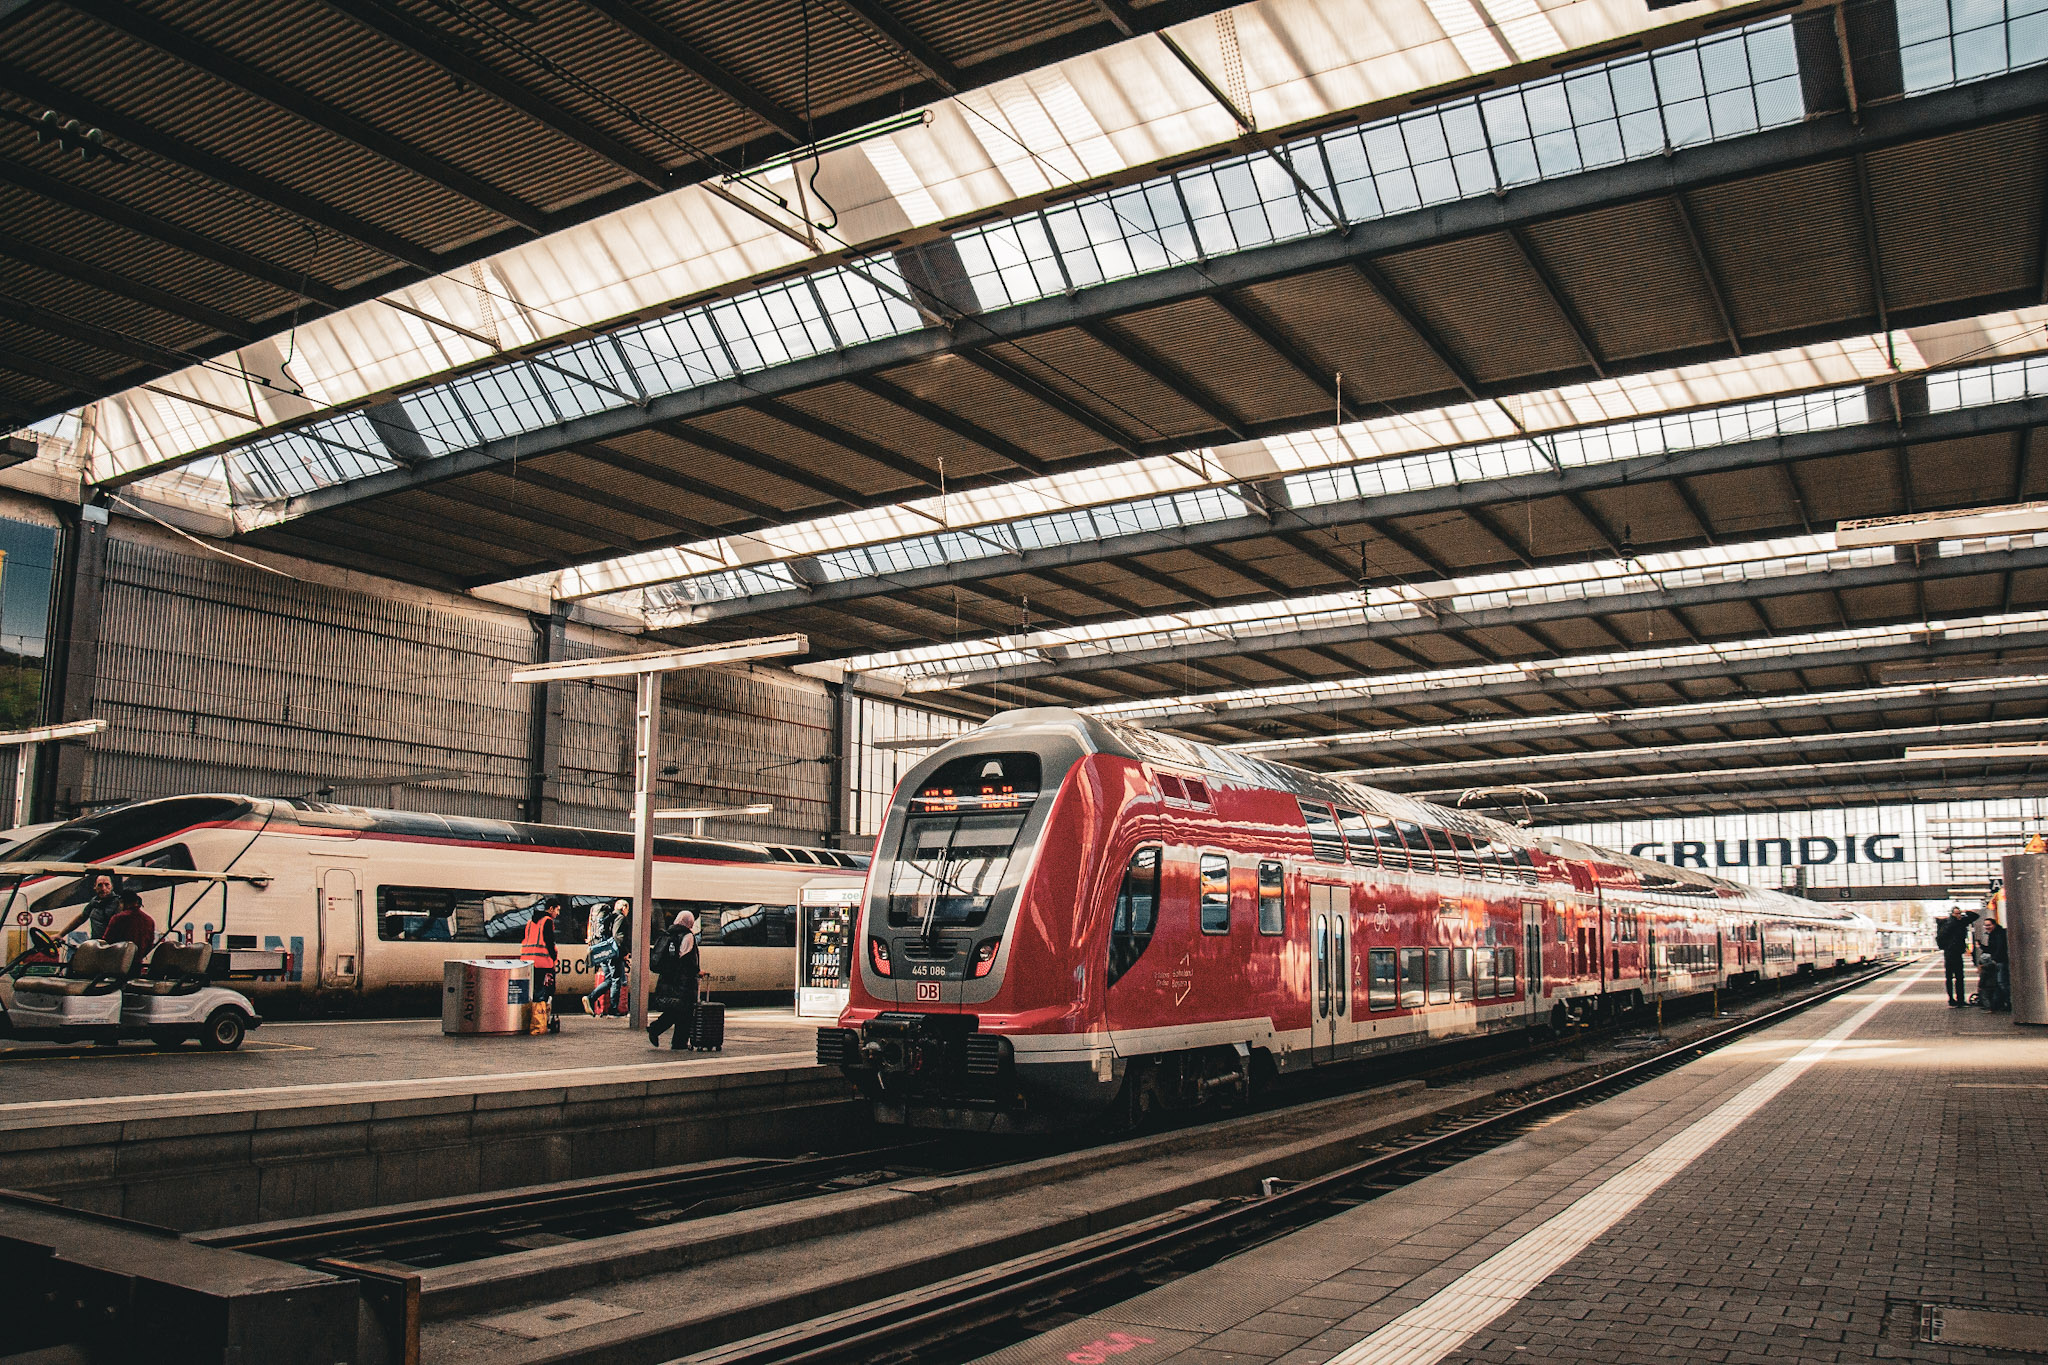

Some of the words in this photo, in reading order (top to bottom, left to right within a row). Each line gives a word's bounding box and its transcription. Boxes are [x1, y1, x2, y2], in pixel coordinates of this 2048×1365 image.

[1630, 834, 1904, 868] GRUNDIG
[1991, 879, 2002, 890] A
[555, 958, 571, 974] BB
[912, 965, 928, 976] 445
[930, 966, 946, 976] 086
[1355, 955, 1361, 976] 2
[919, 984, 938, 999] DB
[464, 981, 475, 1022] Abfall
